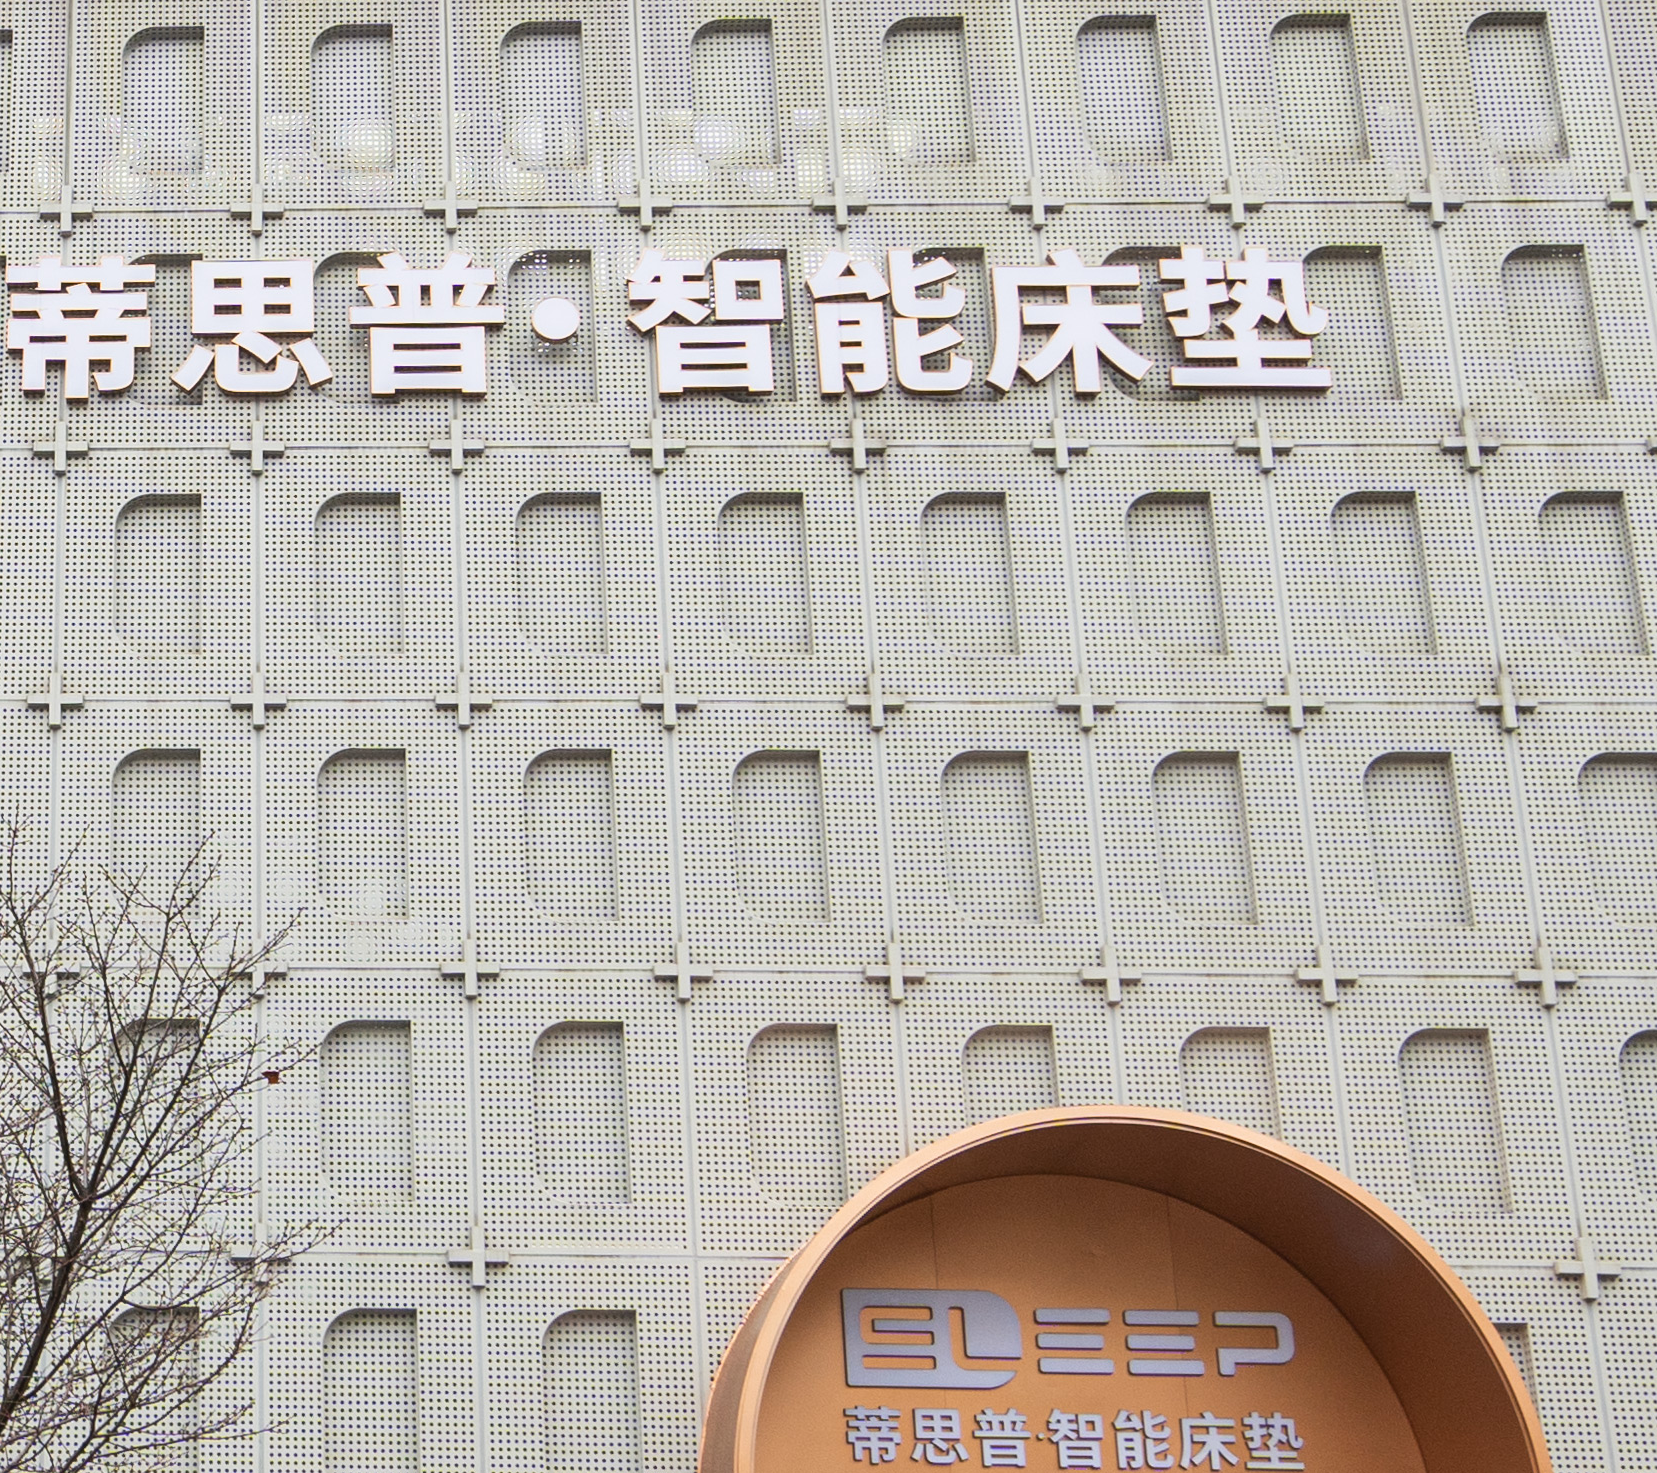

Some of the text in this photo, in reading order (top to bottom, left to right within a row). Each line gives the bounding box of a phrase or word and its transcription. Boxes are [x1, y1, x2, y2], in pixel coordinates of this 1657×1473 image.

[4, 248, 1332, 398] 蒂思普·智能床垫
[844, 1406, 1306, 1471] 蒂思普·智能床垫
